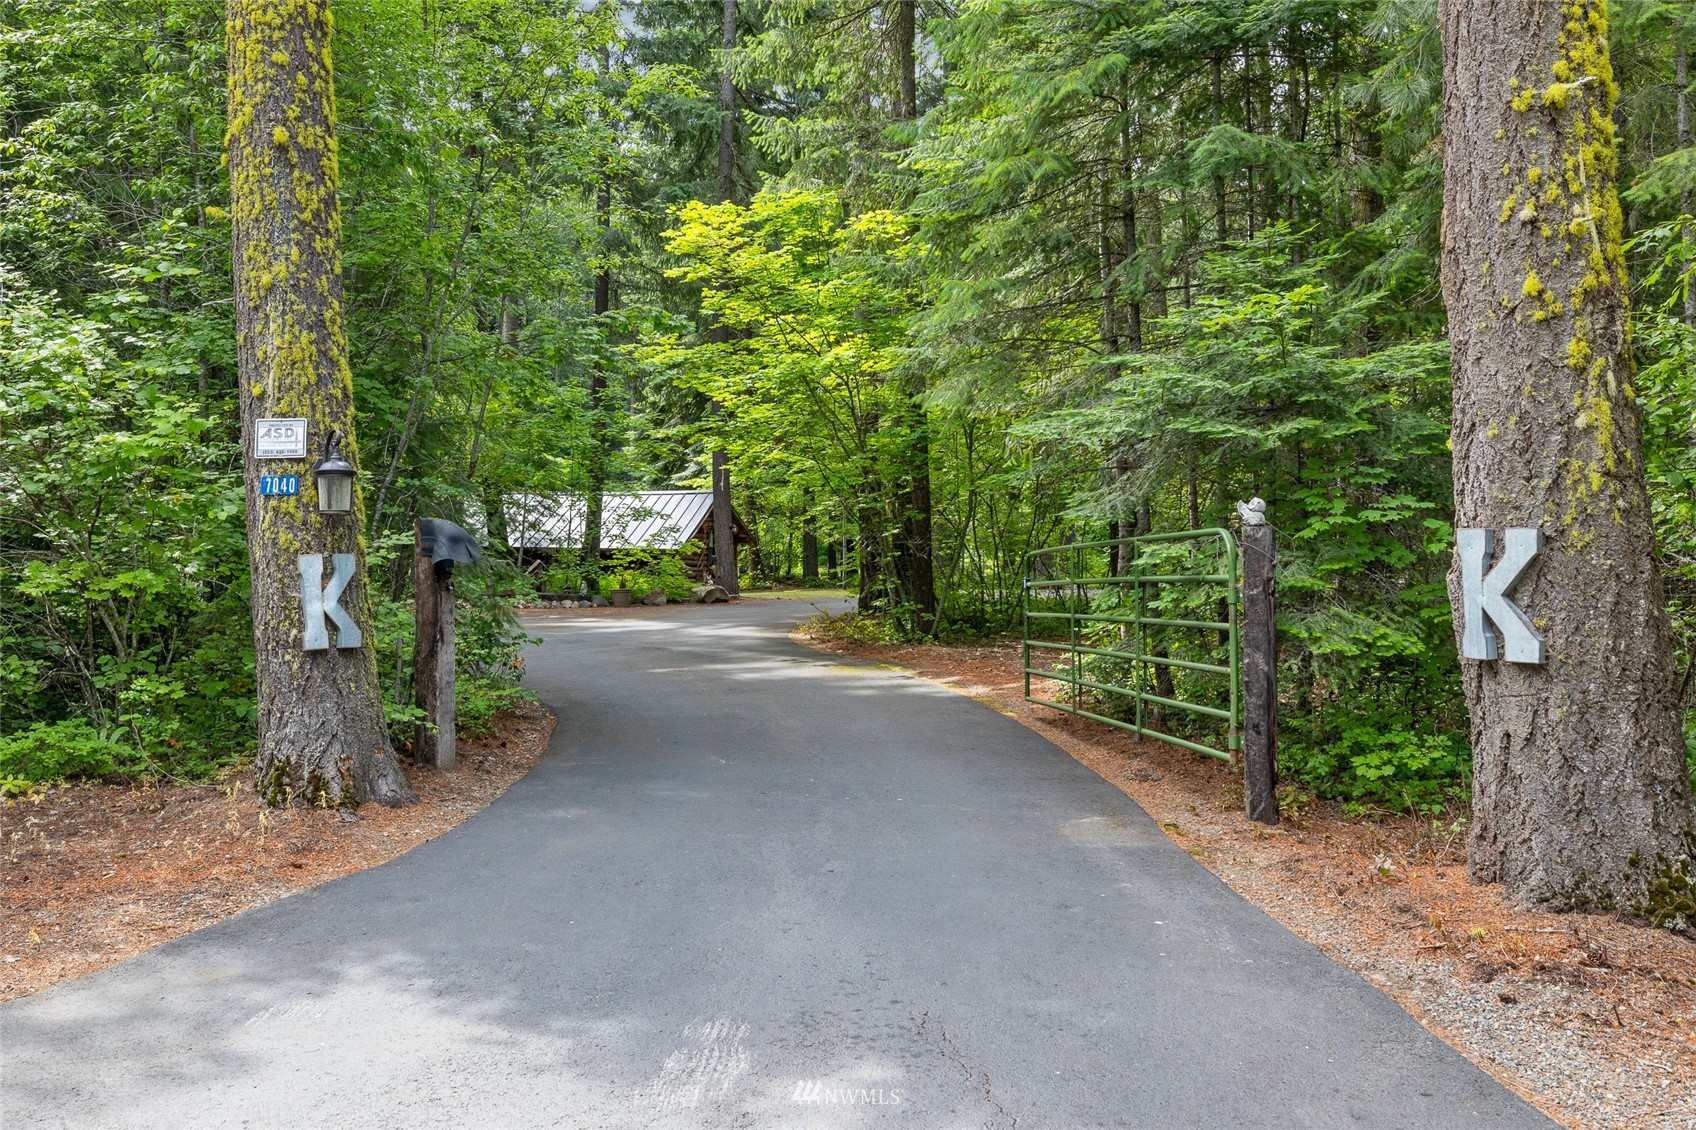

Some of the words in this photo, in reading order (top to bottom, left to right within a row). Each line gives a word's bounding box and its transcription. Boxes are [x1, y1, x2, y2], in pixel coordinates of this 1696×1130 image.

[260, 427, 295, 439] ASD
[265, 477, 295, 493] 7040
[297, 553, 362, 651] K
[1457, 528, 1546, 664] K
